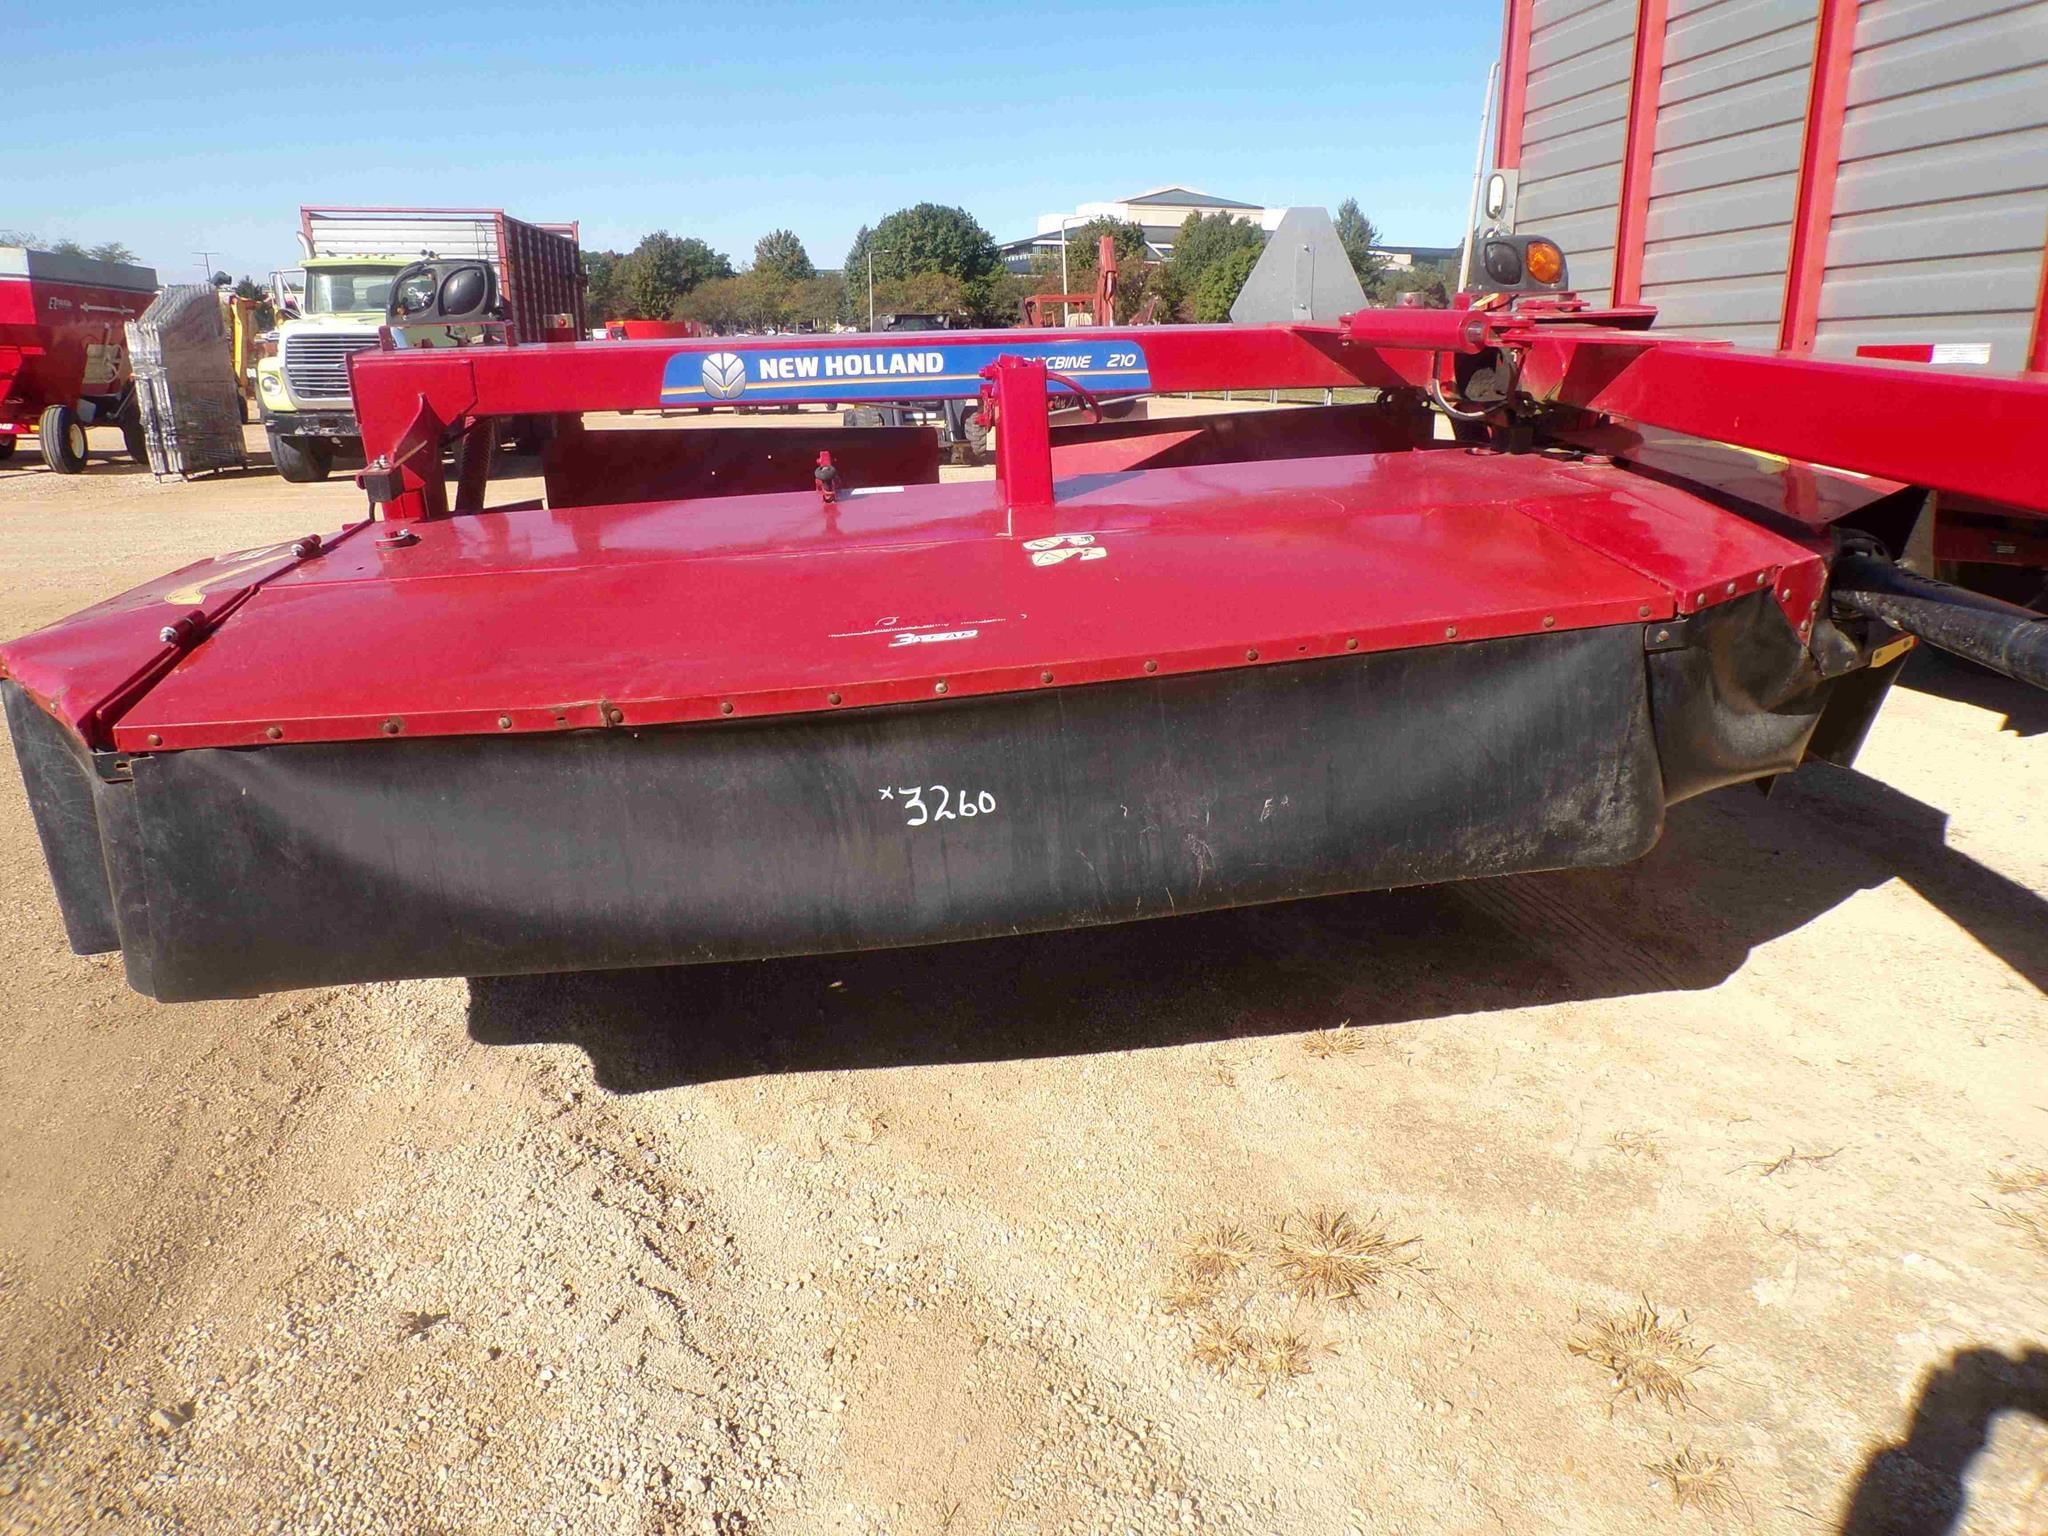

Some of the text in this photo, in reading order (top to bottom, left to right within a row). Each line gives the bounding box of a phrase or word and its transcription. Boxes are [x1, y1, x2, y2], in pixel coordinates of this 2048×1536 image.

[760, 352, 944, 379] NEW HOLLAND
[1023, 354, 1137, 369] CBINE 210
